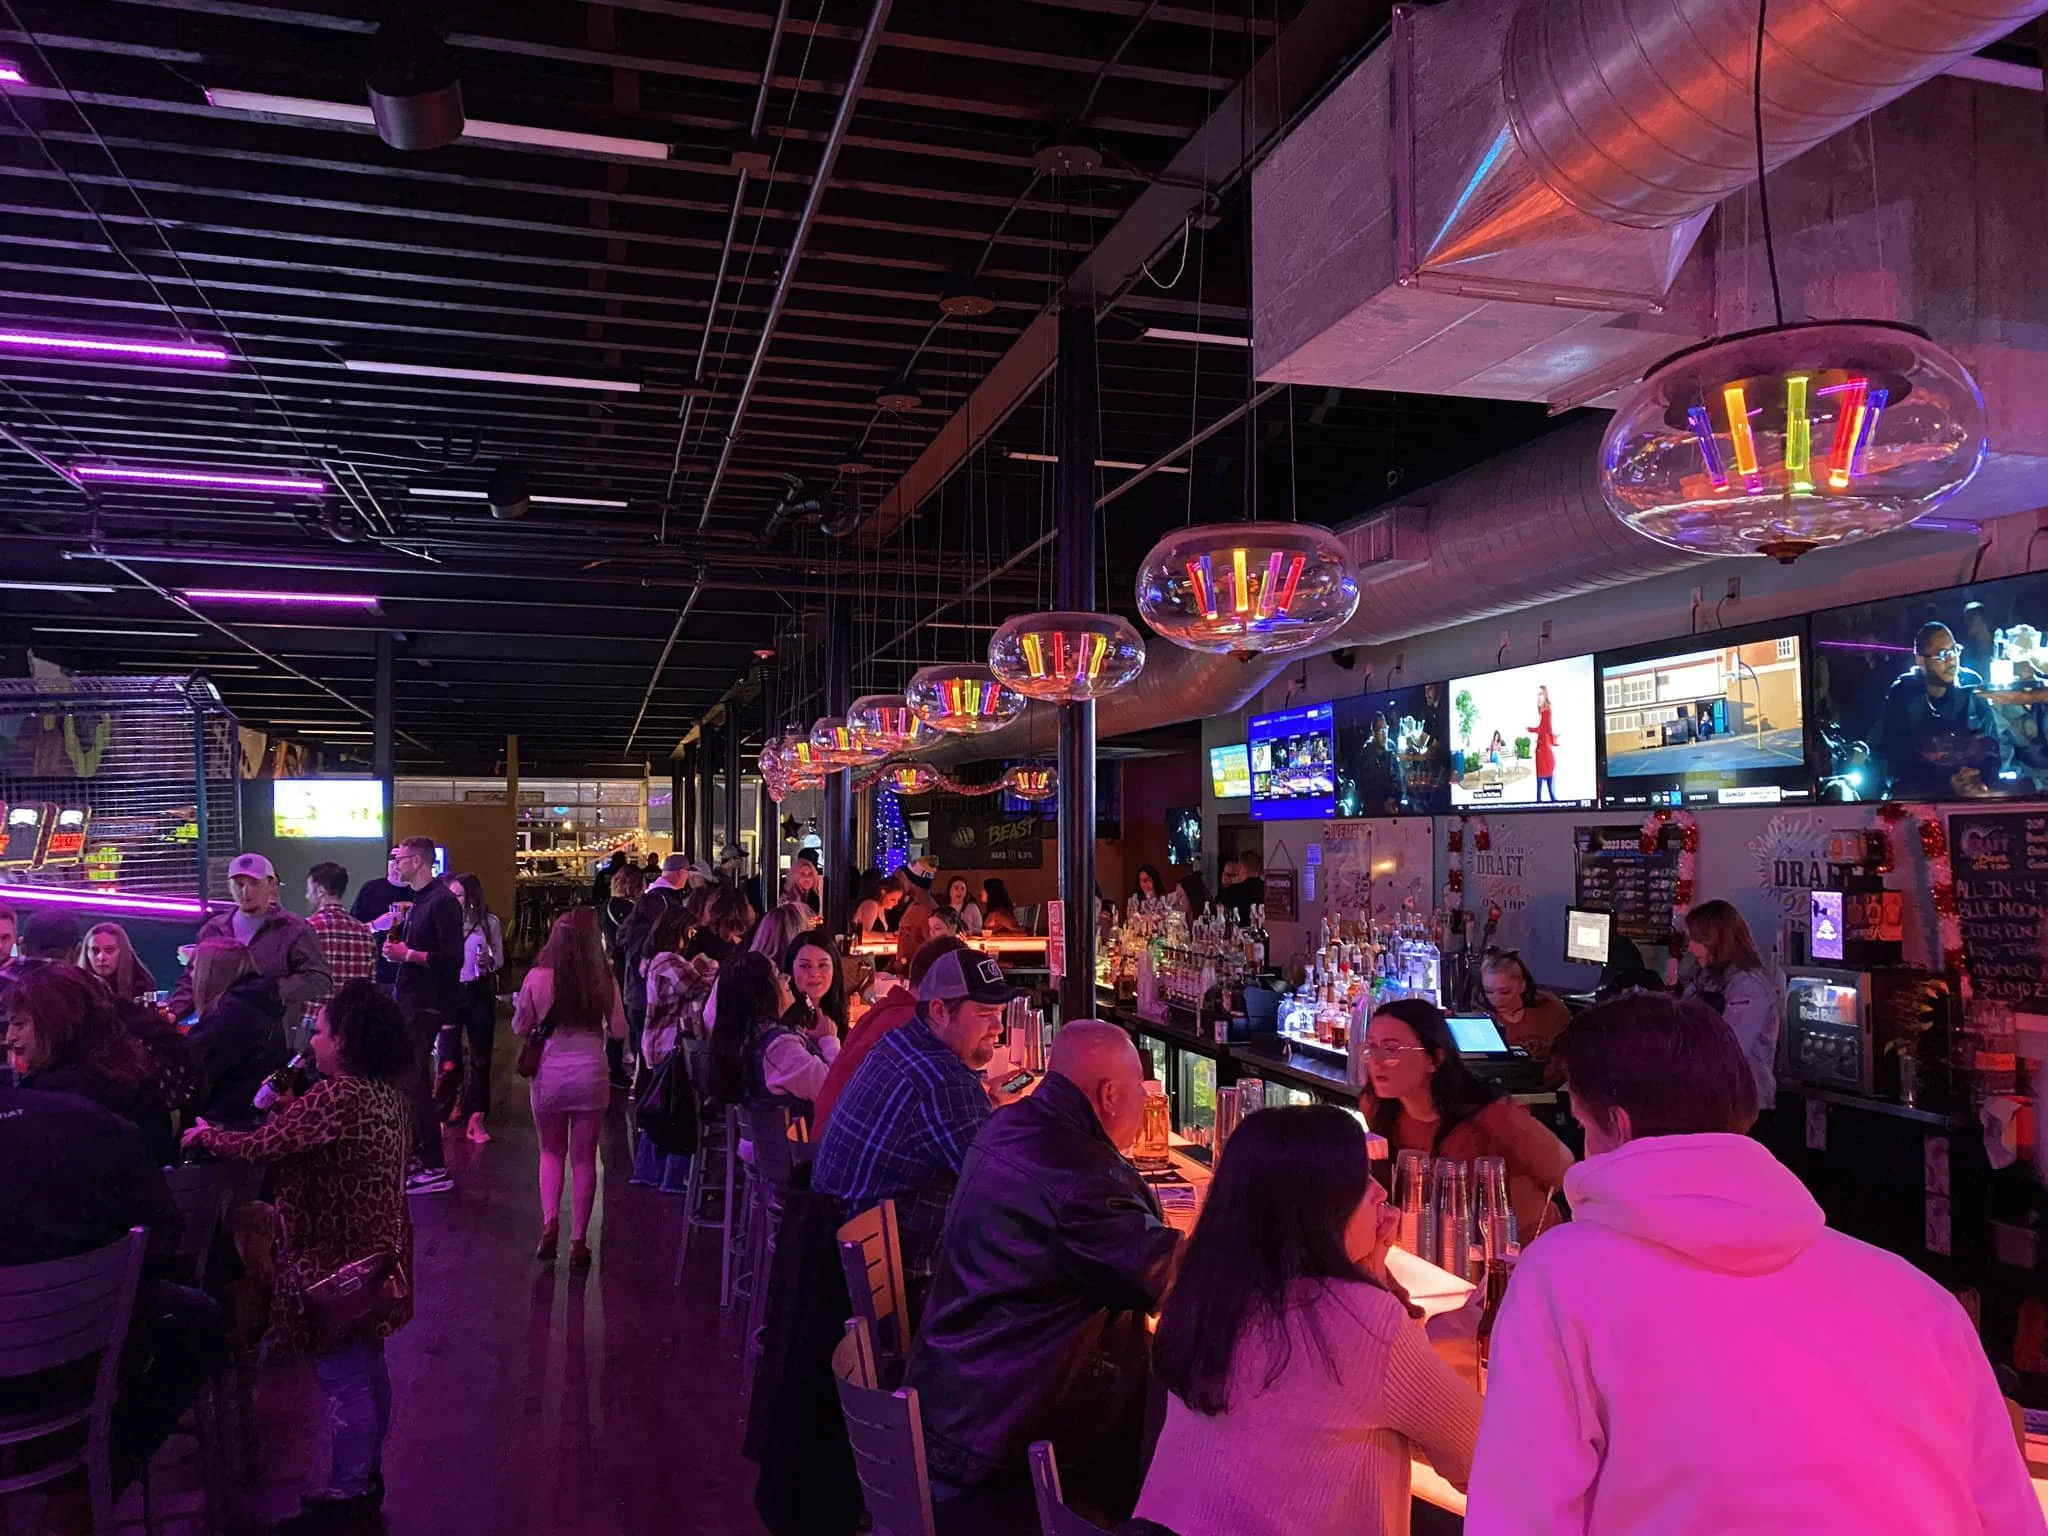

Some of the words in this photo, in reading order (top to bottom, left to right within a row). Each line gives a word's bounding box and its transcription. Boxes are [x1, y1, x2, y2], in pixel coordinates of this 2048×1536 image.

[984, 817, 1037, 847] BEAST
[1476, 854, 1524, 877] DRAFT
[1774, 860, 1841, 888] DRAF
[1800, 1005, 1820, 1021] Red
